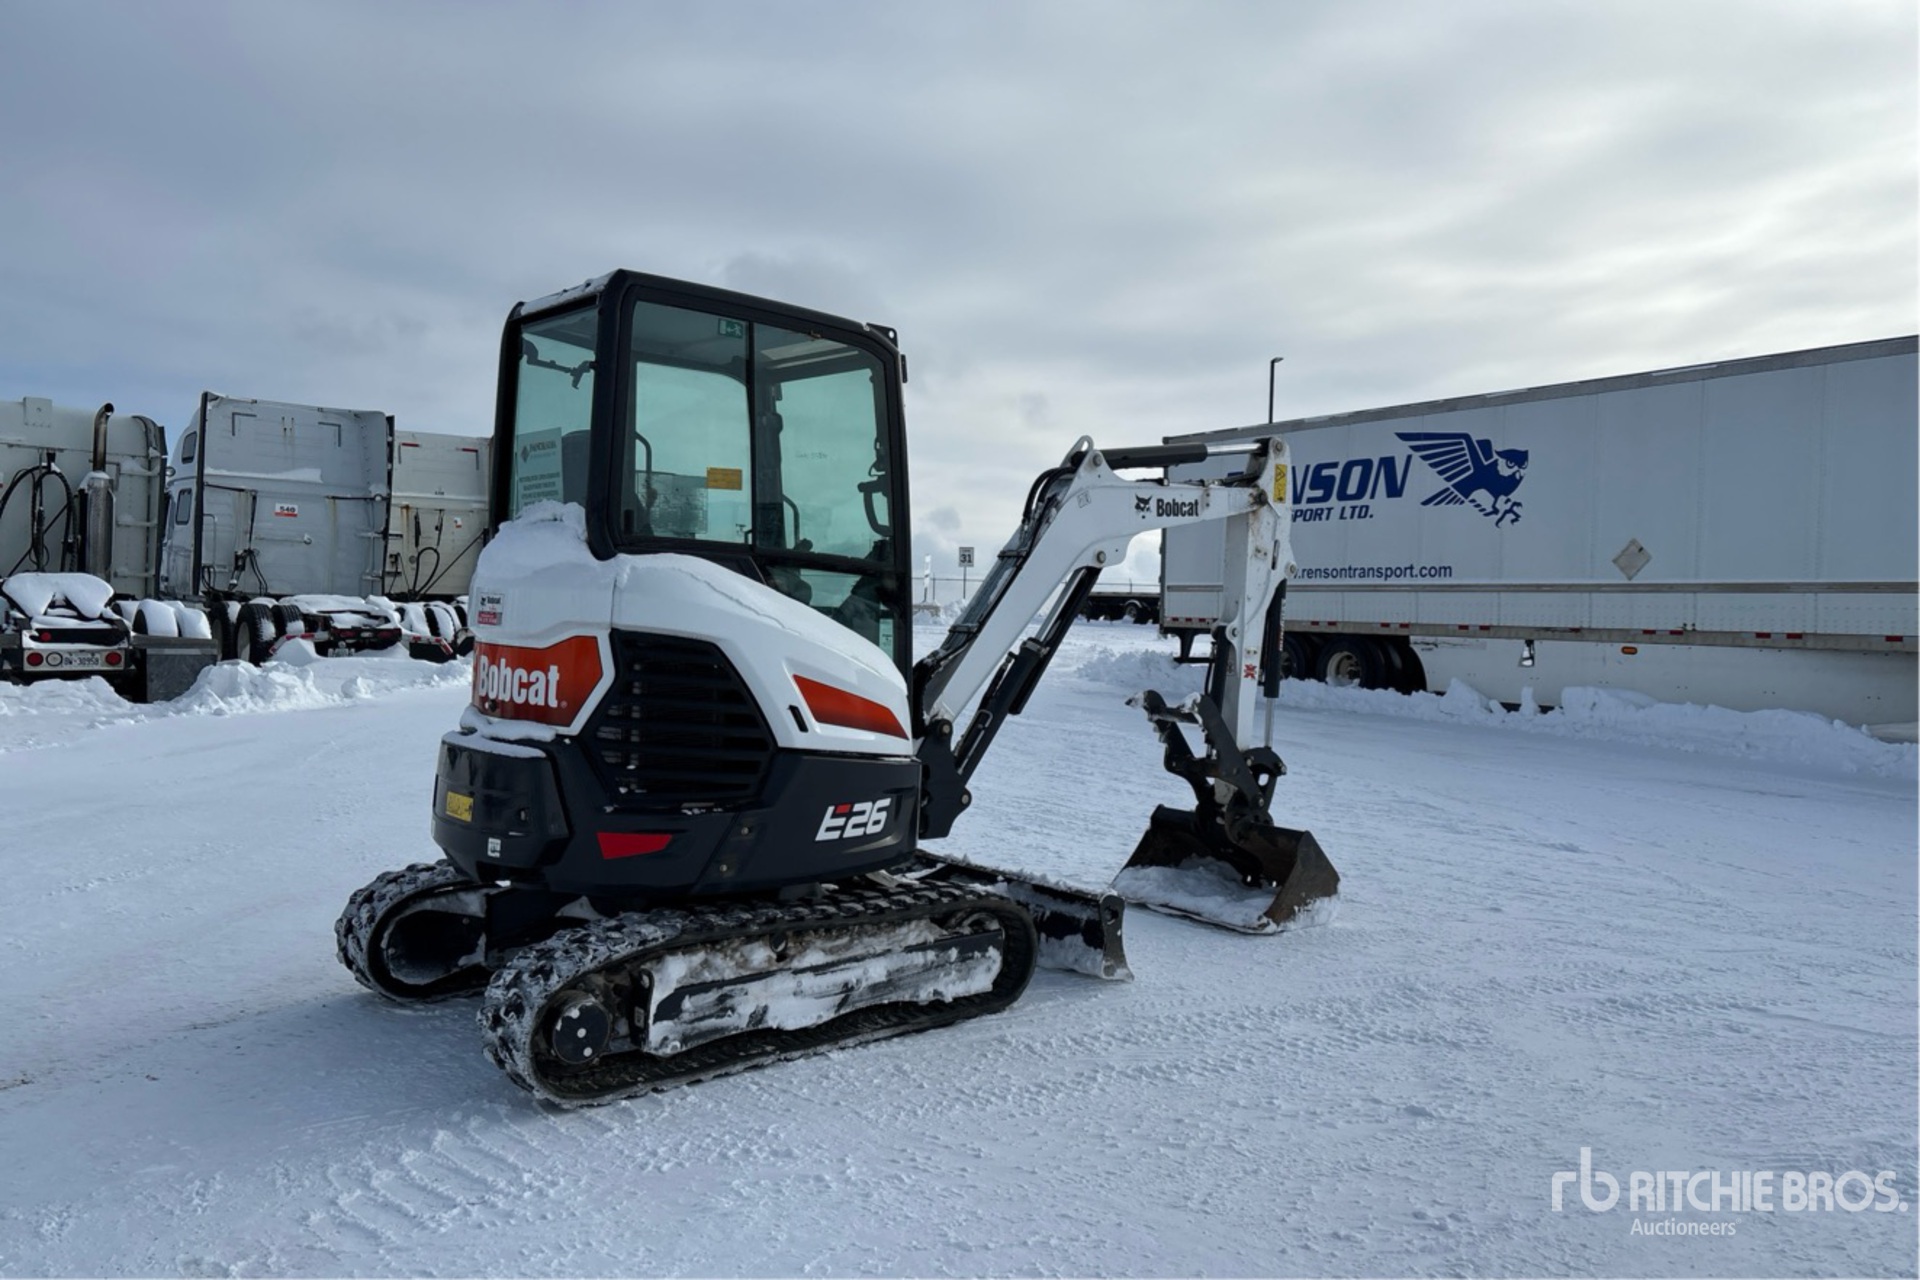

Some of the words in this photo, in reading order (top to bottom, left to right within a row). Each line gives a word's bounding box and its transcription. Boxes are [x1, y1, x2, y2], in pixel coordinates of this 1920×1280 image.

[1292, 454, 1413, 505] NSON
[1156, 498, 1199, 517] Bobcat
[1292, 507, 1334, 522] PORT
[1339, 505, 1374, 520] LTD.
[960, 553, 973, 564] 31
[478, 655, 560, 708] Bobcat
[815, 797, 892, 842] E26
